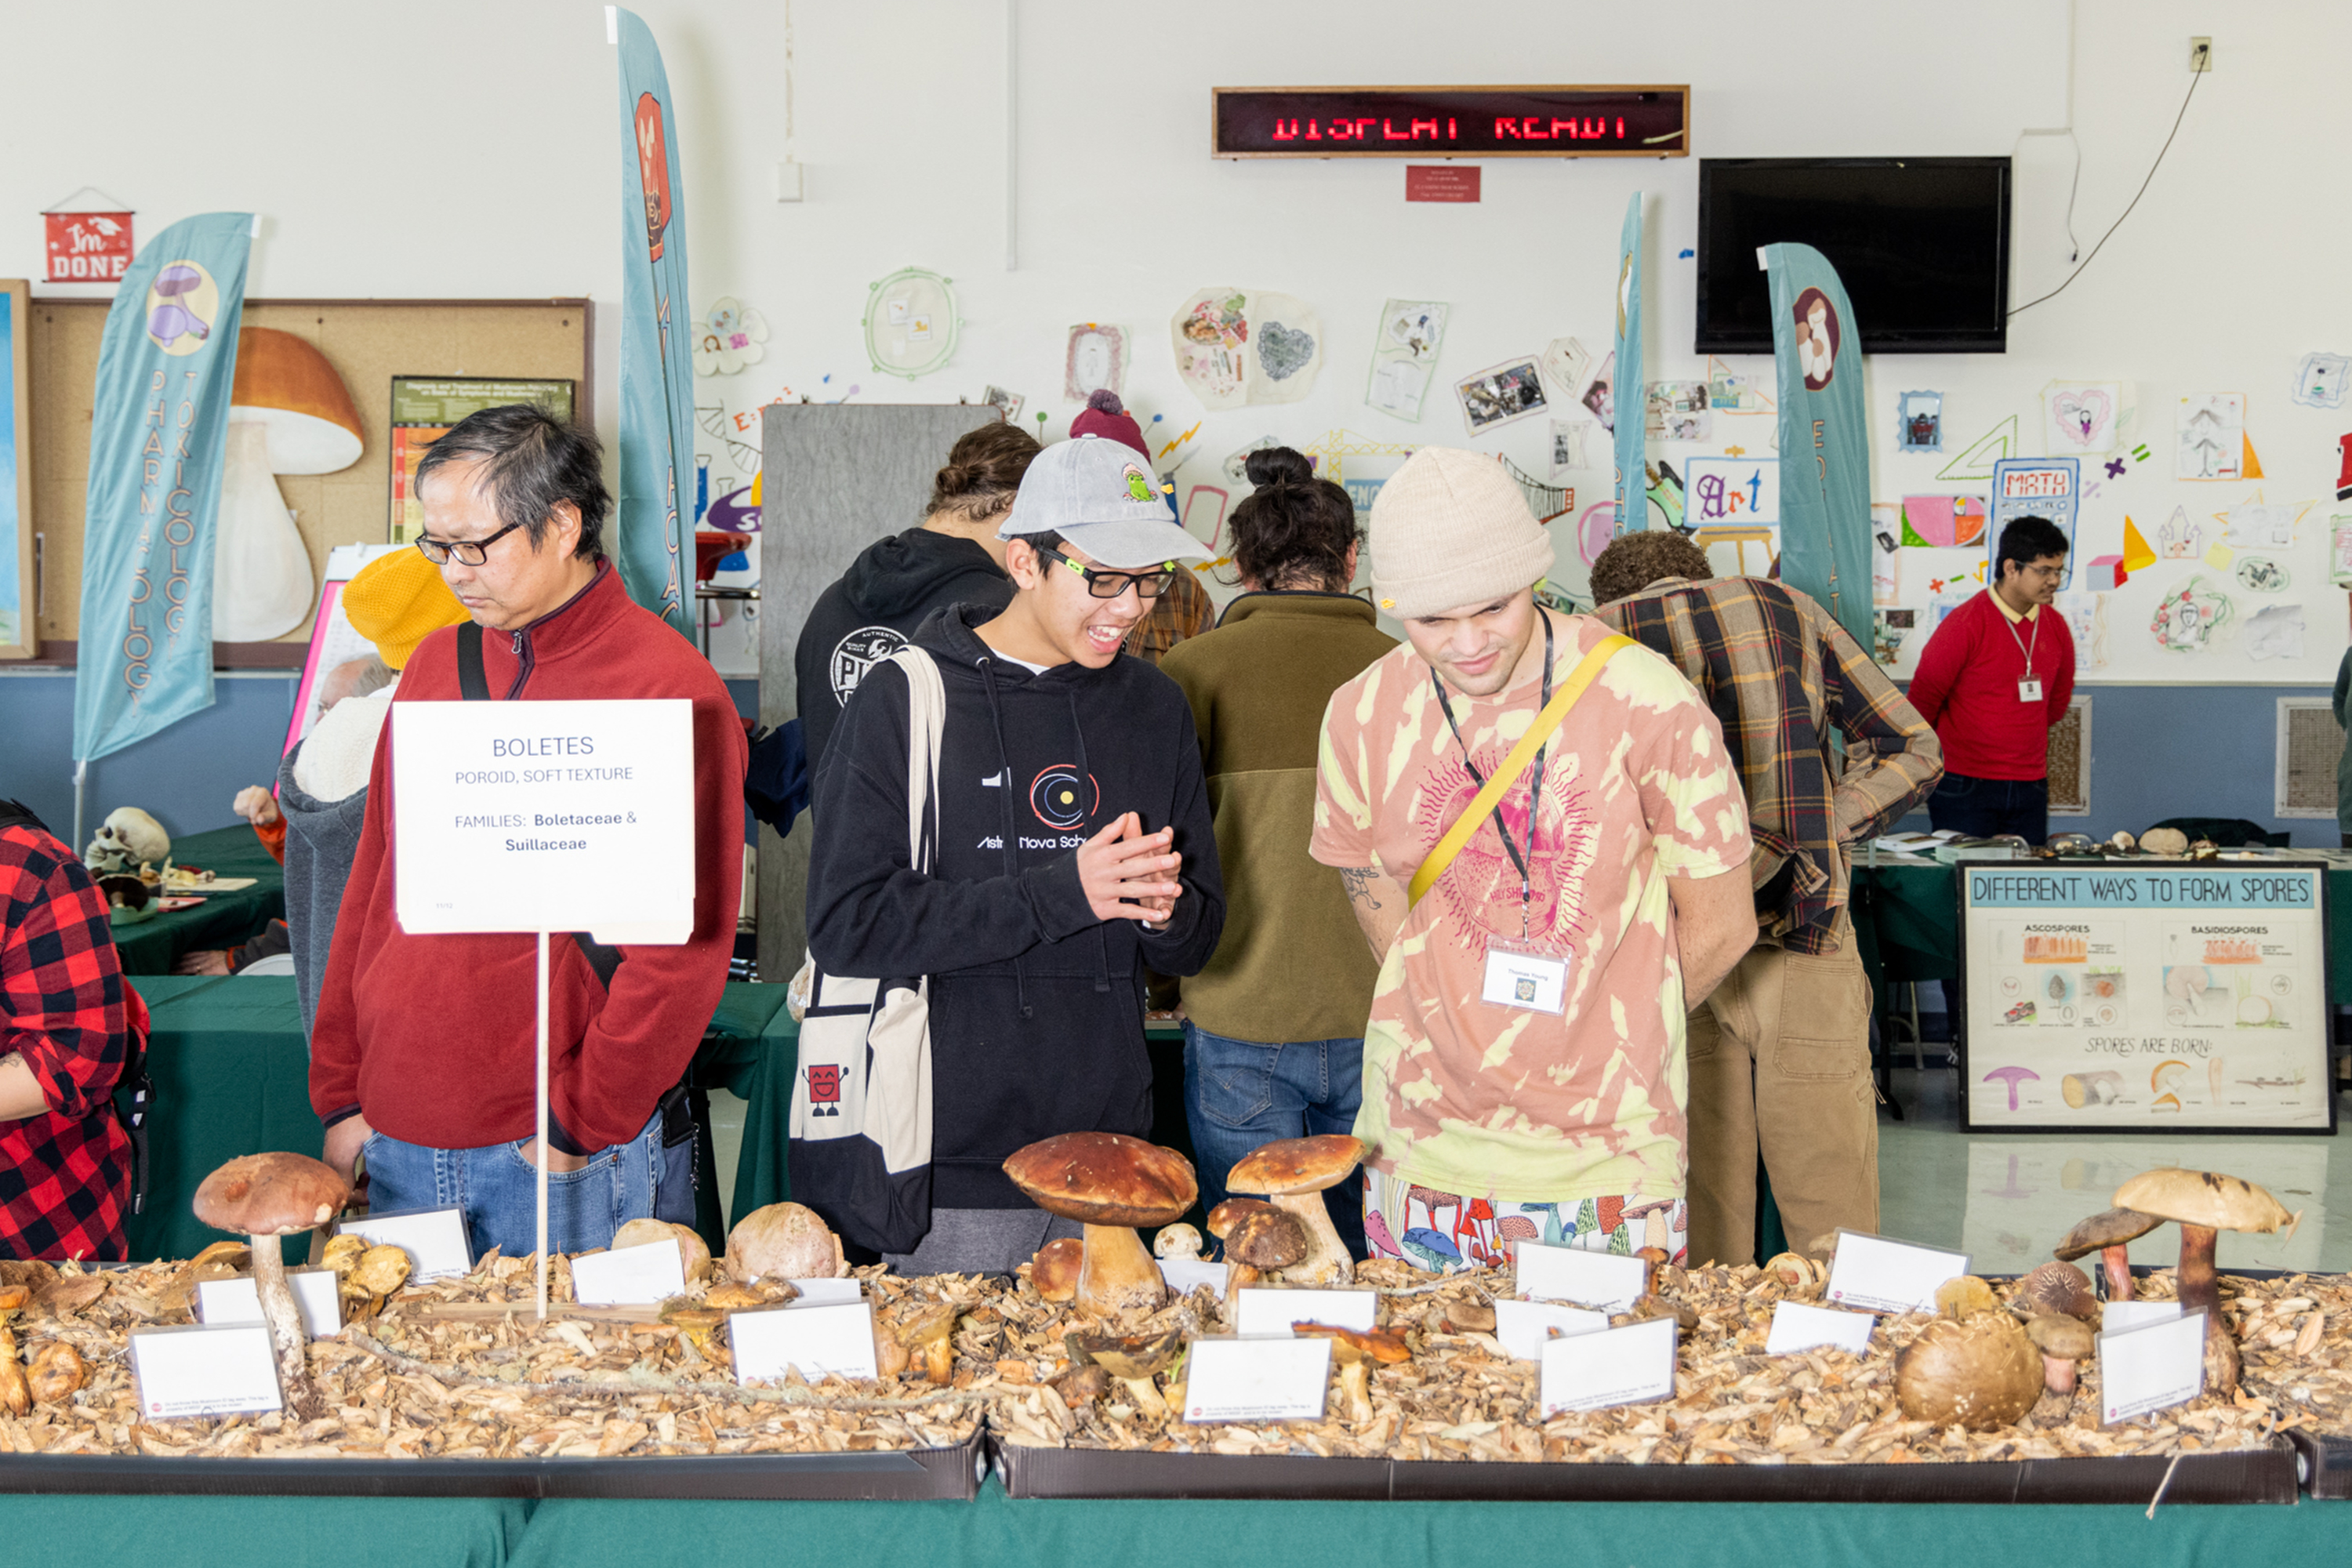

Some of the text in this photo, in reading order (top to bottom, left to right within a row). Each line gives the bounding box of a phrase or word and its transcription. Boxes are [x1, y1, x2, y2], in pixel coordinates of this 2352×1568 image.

[66, 223, 107, 254] I'm
[53, 256, 127, 278] DONE
[2006, 474, 2066, 495] MATH
[163, 372, 198, 662] TOXICOLOGY
[123, 369, 167, 717] PHARMACOLOGY
[862, 631, 899, 642] AUTHENTIC
[492, 736, 594, 757] BOLETES
[456, 767, 633, 784] POROID, SOFT TEXTURE
[455, 811, 637, 828] FAMILIES: Boletaceae &
[505, 838, 587, 851] Suillaceae
[977, 835, 1004, 848] Astr
[1019, 837, 1057, 849] Nova
[1973, 877, 2310, 902] DIFFERENT WAYS TO FORM SPORES
[2024, 924, 2091, 933] ASCOSPORES
[2190, 925, 2269, 935] BASIDIOSPORES
[2085, 1038, 2213, 1058] SPORES ARE BORN:
